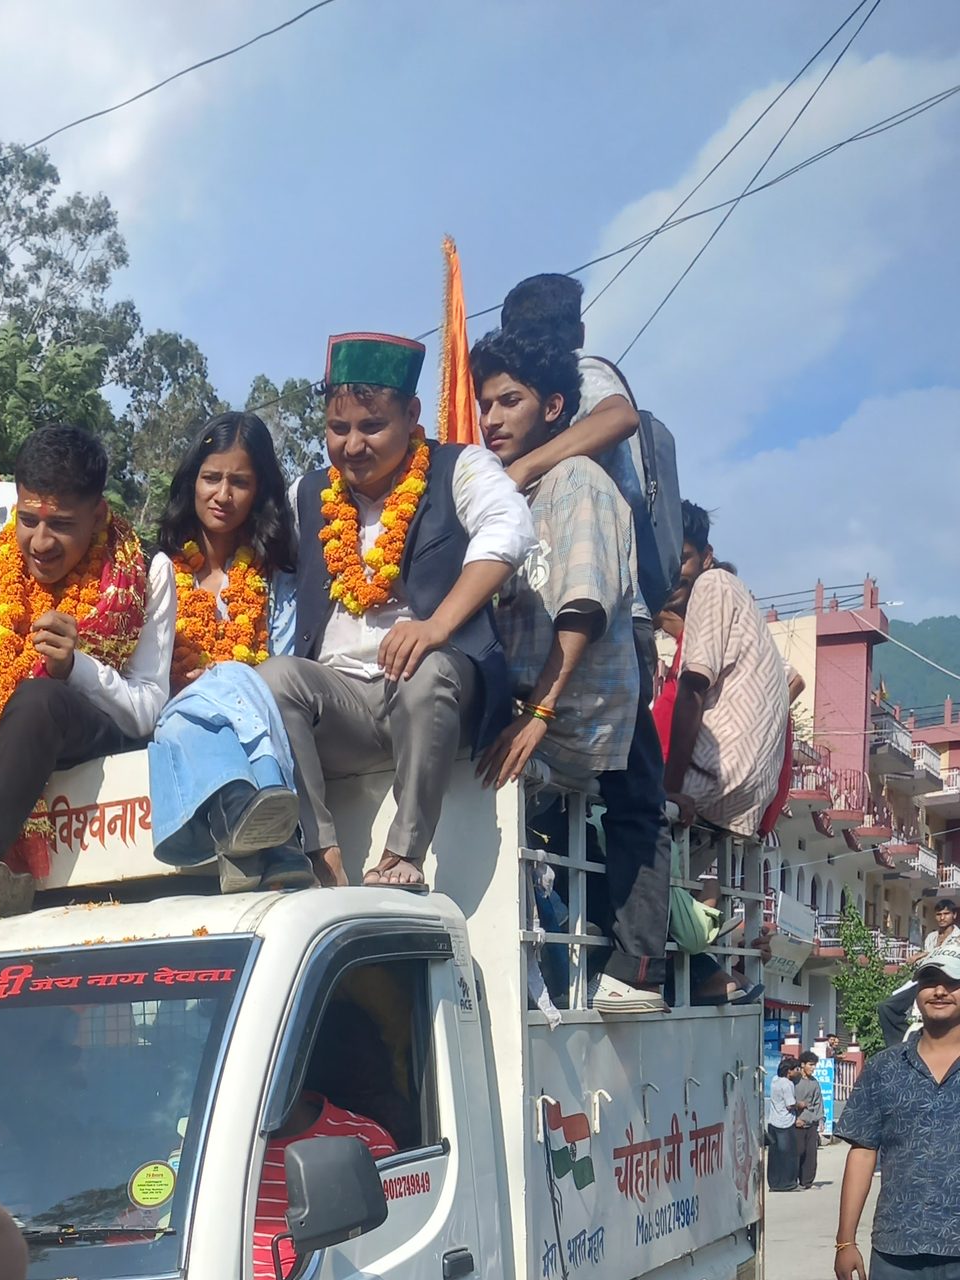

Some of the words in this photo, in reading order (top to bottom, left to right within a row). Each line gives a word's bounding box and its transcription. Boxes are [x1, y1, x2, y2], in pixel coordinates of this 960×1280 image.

[87, 972, 149, 986] नाग
[154, 967, 236, 985] देवता
[460, 999, 473, 1011] ACE
[663, 1113, 684, 1184] जी
[383, 1171, 431, 1201] 9012749849
